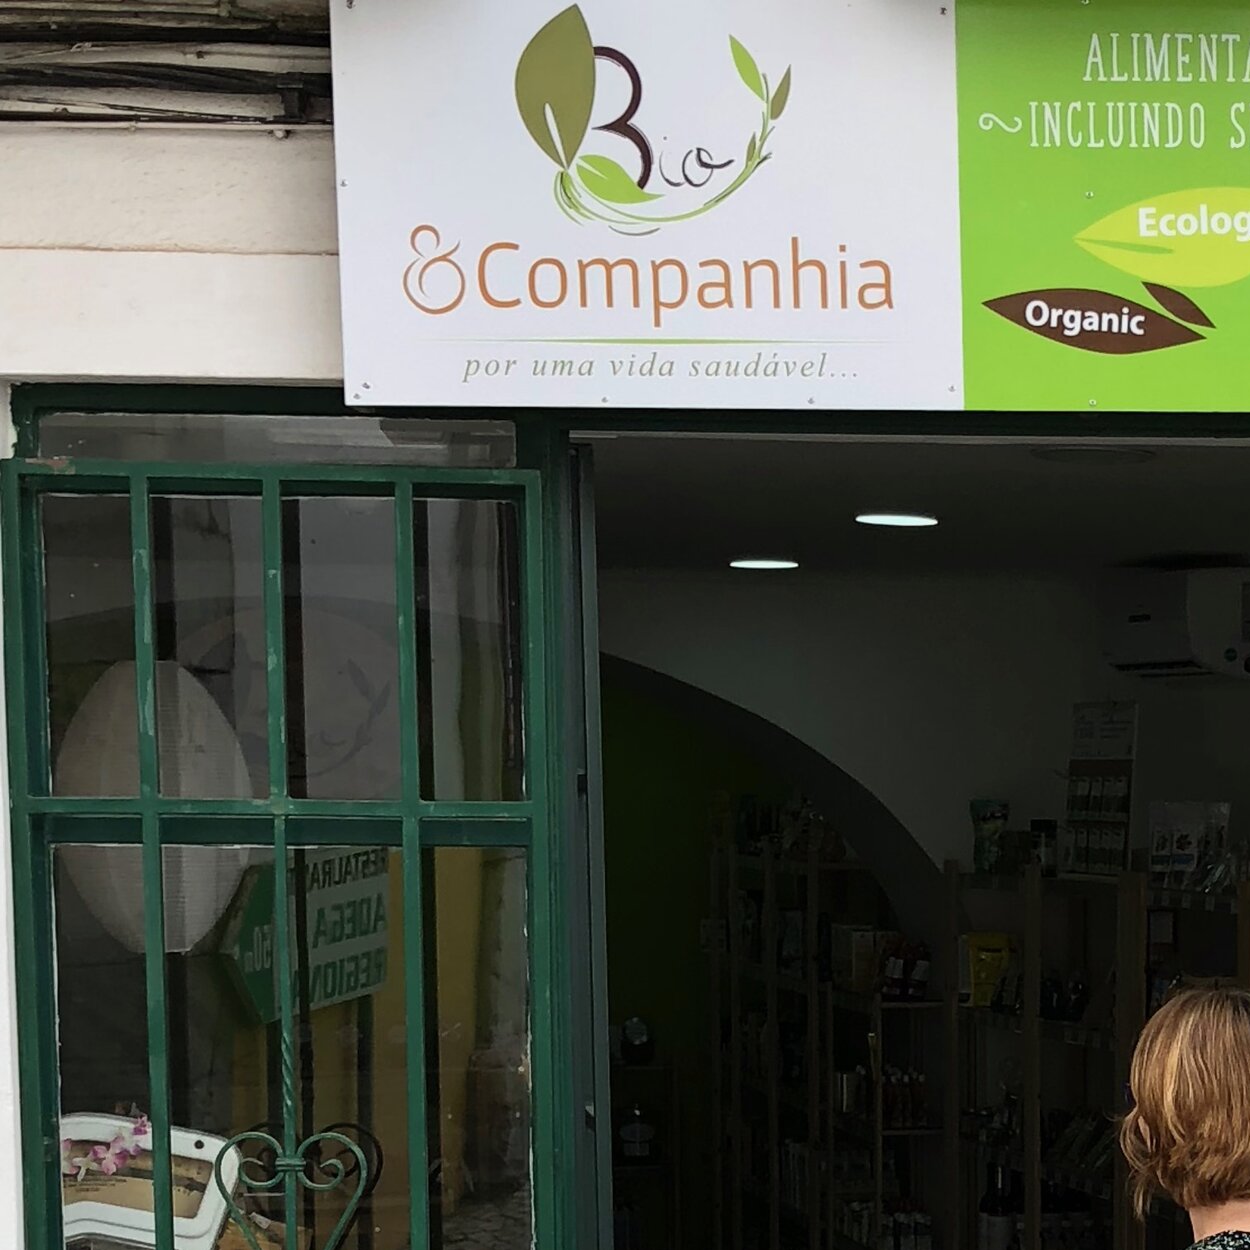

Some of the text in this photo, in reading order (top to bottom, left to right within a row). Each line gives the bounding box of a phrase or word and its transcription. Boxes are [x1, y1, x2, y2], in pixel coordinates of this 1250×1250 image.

[1029, 101, 1206, 149] INCLUINDO
[1024, 299, 1145, 337] Organic
[462, 352, 860, 384] por uma vida saudável...
